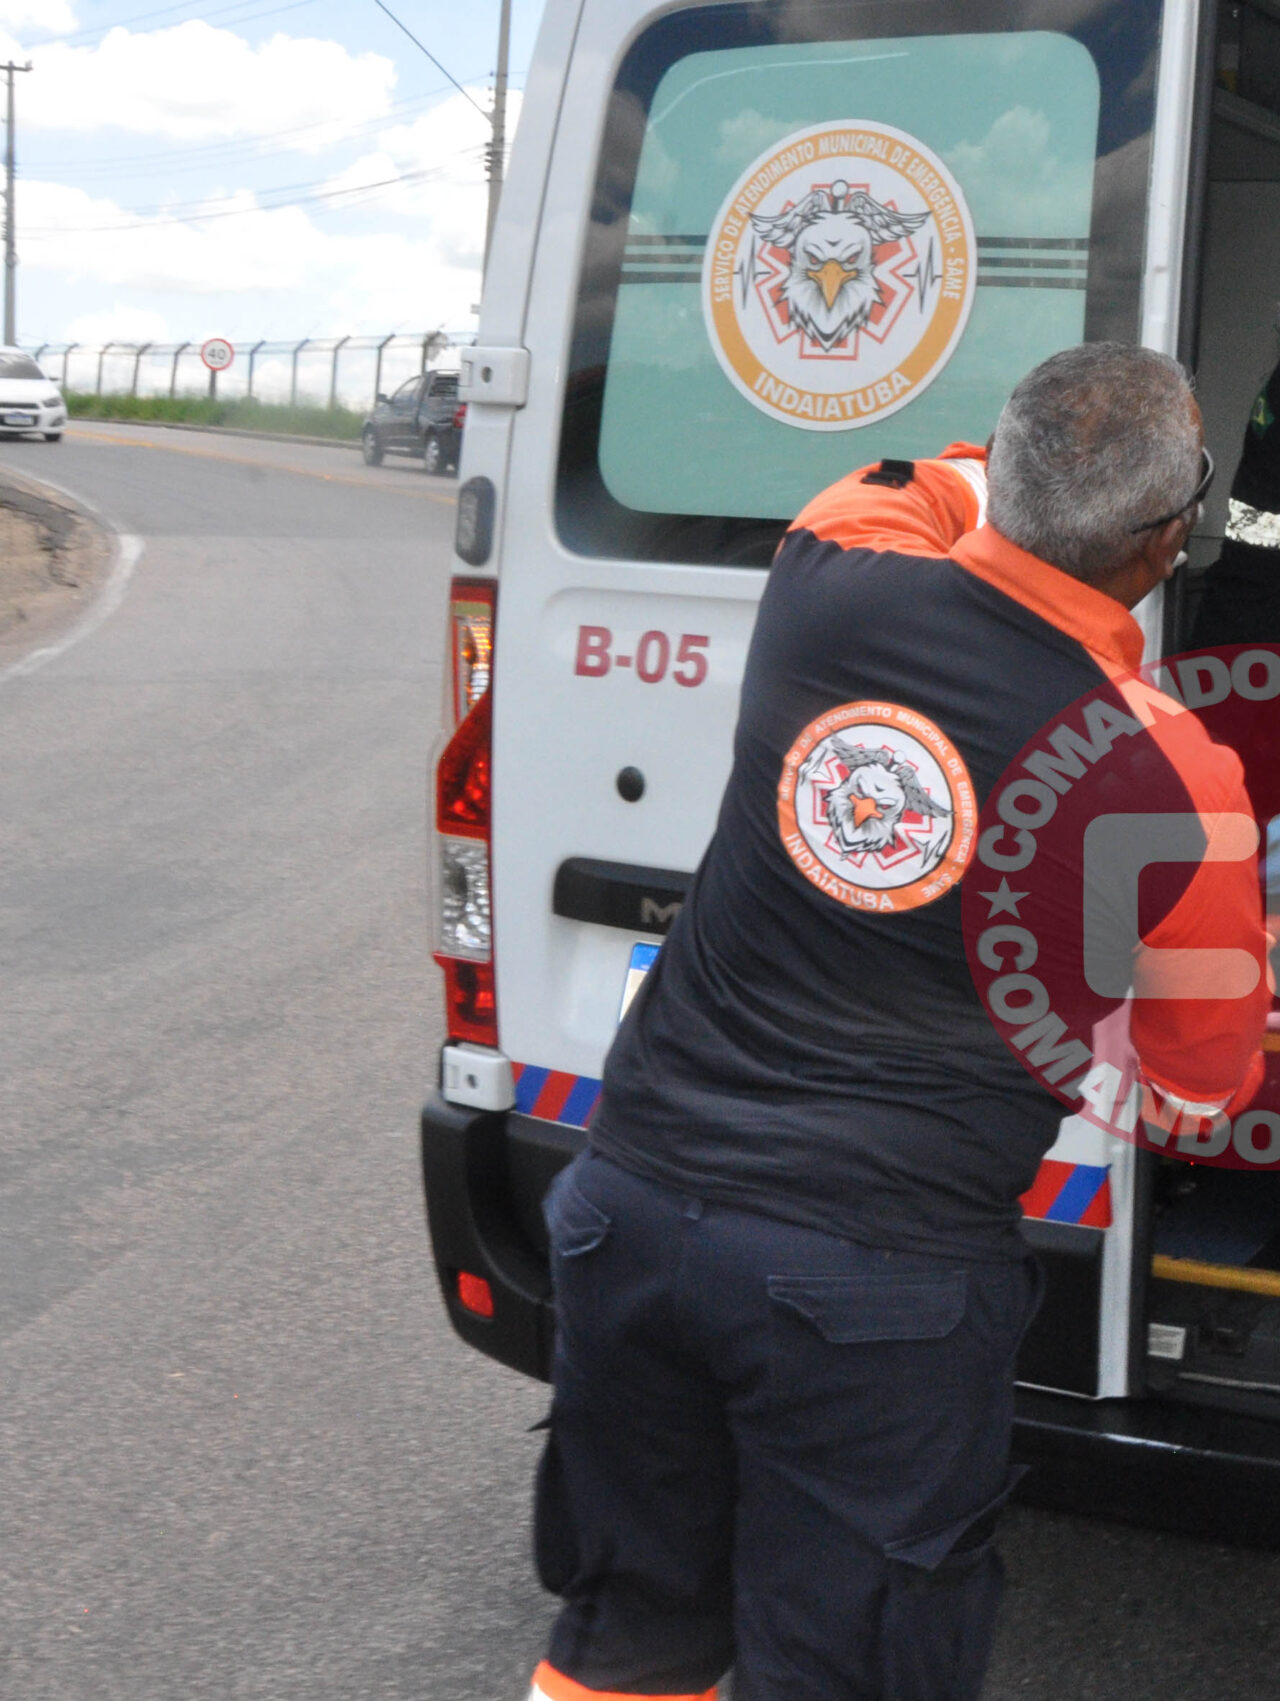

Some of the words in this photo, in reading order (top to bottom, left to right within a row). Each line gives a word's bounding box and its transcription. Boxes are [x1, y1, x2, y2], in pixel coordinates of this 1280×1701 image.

[713, 238, 735, 302] SERVIÇO
[724, 214, 743, 238] DE
[735, 141, 815, 217] ATENDIMENTO
[818, 133, 891, 158] MUNICIPAL
[889, 146, 911, 170] DE
[943, 257, 965, 300] SAME
[207, 348, 226, 361] 40
[754, 370, 912, 420] INDAIATUBA
[573, 625, 710, 688] B-05
[815, 706, 892, 733] ATENDIMENTO
[896, 710, 949, 756] MUNICIPAL
[947, 758, 962, 775] DE
[785, 833, 895, 911] INDAIATUBA
